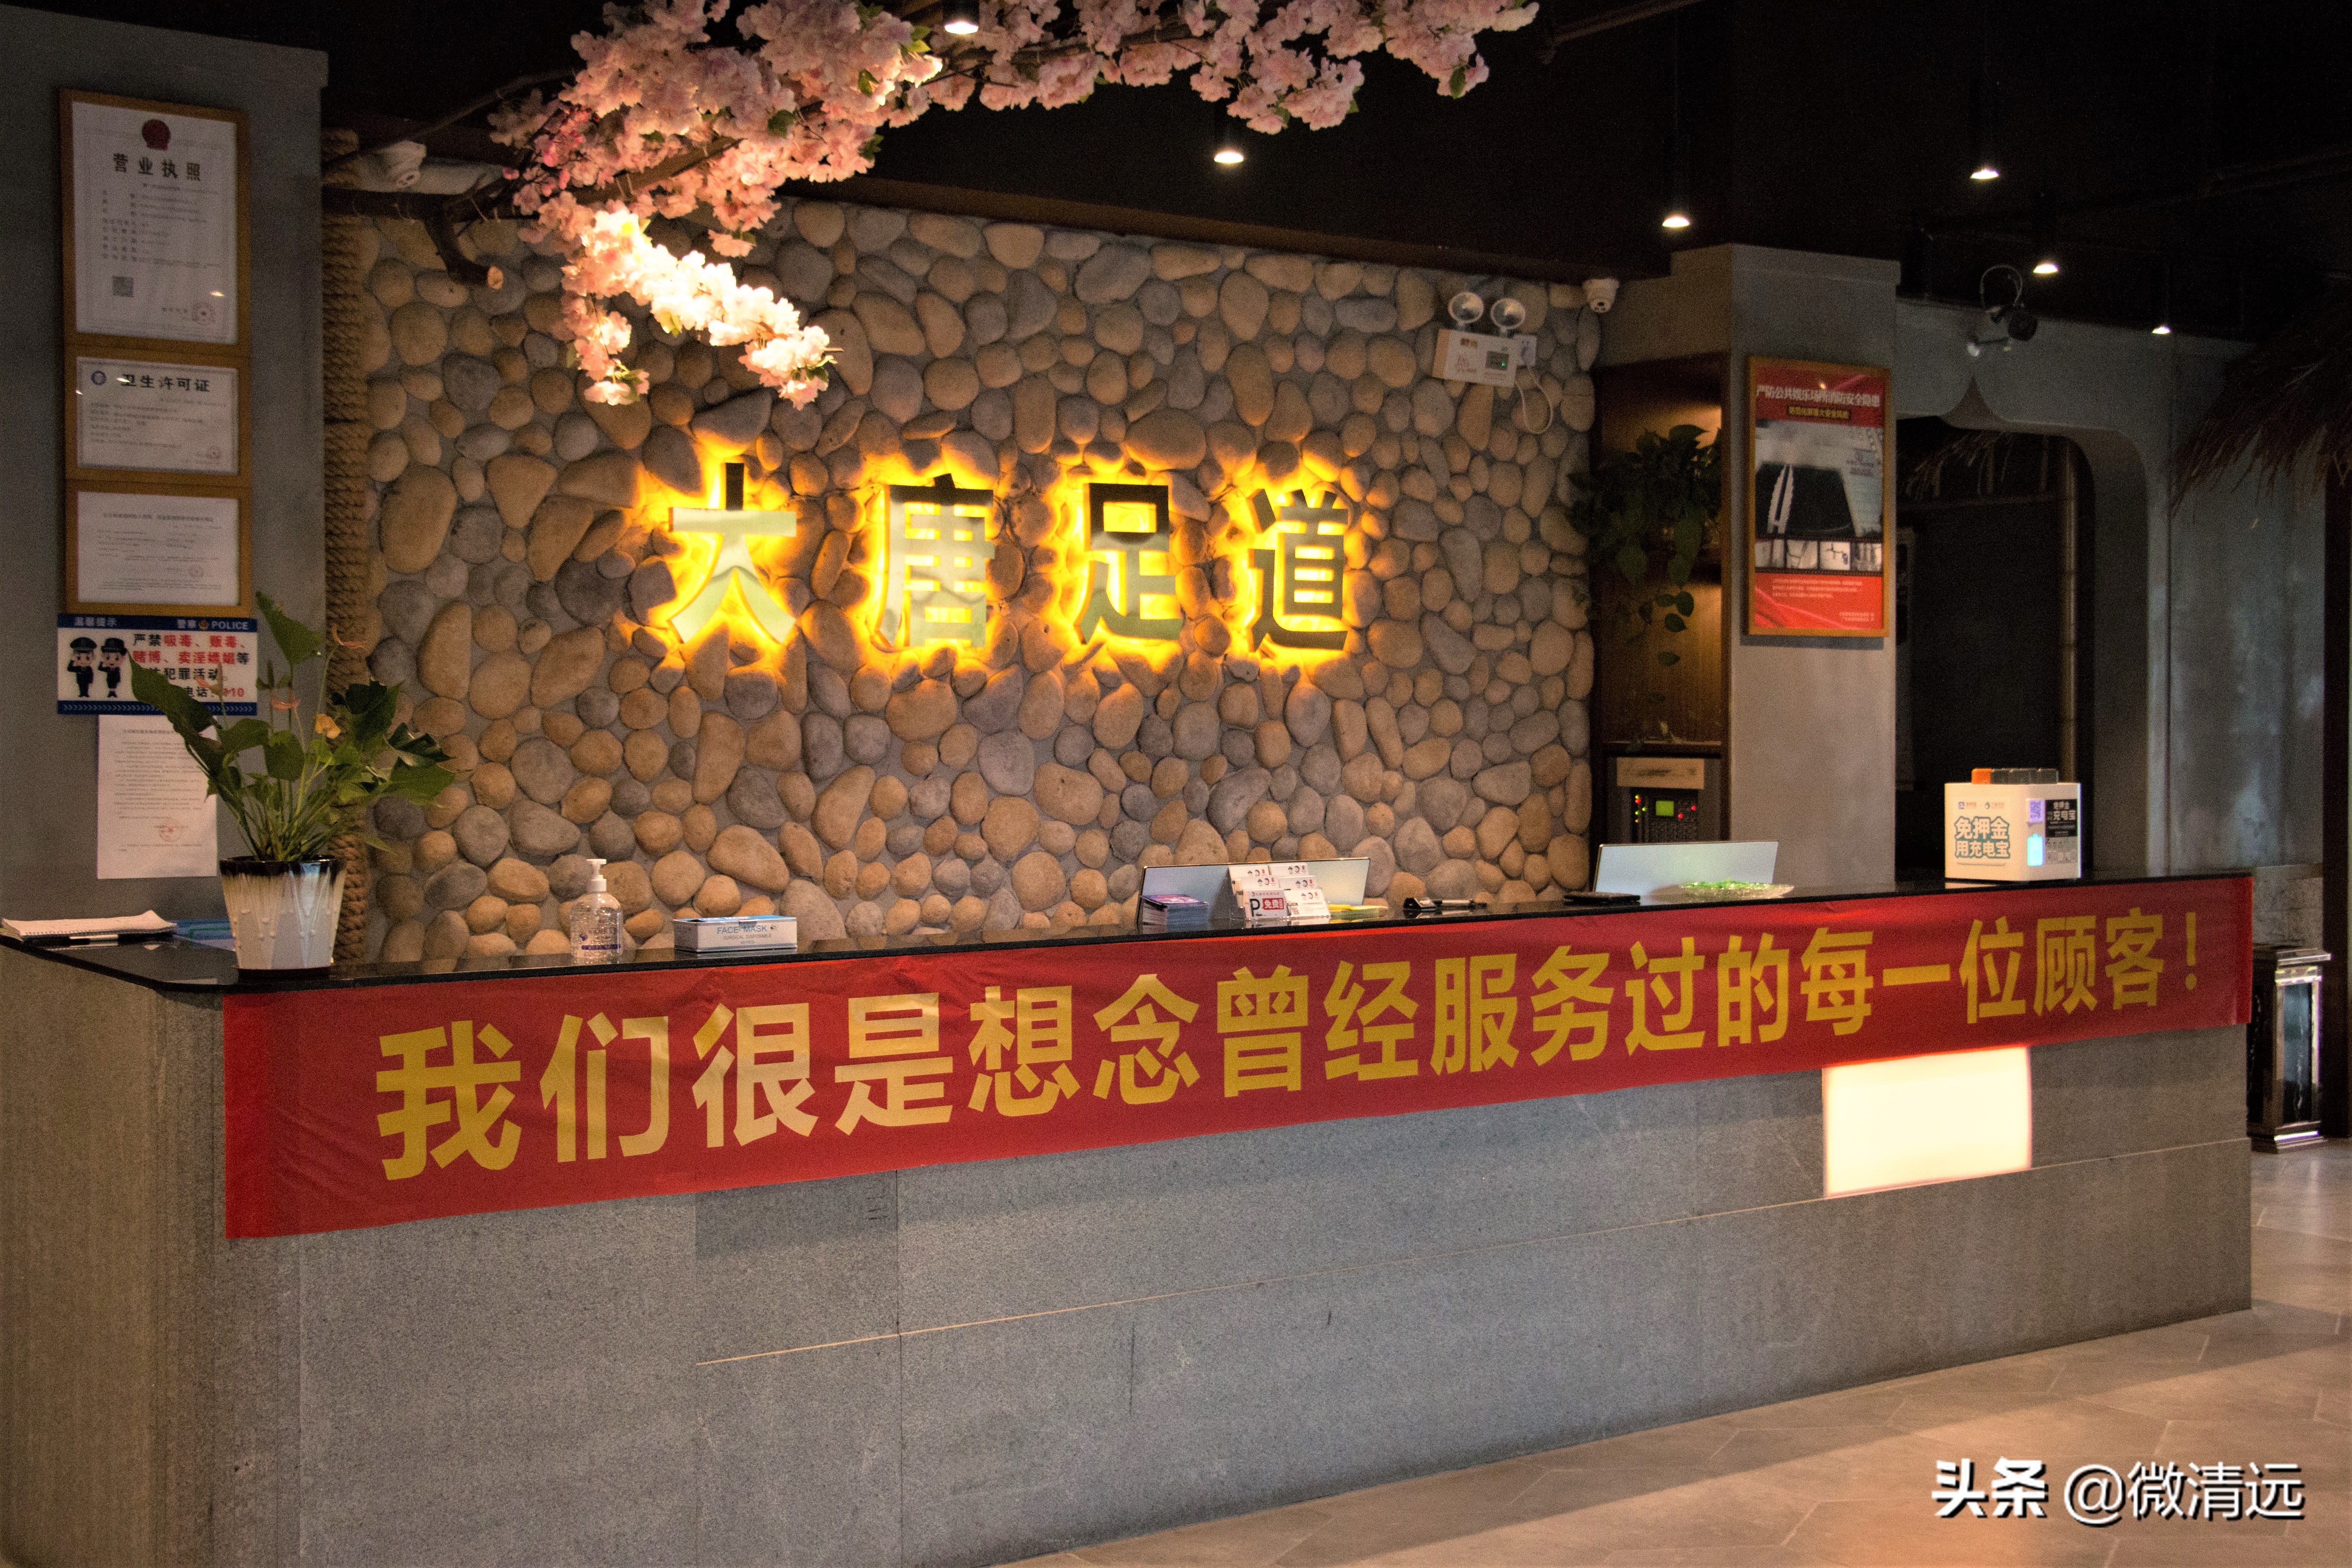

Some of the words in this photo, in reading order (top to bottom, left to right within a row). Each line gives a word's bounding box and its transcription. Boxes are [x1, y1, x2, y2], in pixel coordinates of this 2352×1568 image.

[113, 152, 201, 181] 营业执照
[121, 374, 210, 392] 卫生许可证
[667, 462, 1349, 652] 大唐足道
[177, 620, 196, 629] 警察
[211, 621, 248, 630] POLICE
[1954, 816, 2010, 840] 免押金
[1954, 840, 2011, 859] 用充电宝
[1250, 898, 1260, 917] P
[1264, 899, 1279, 909] 免费
[376, 908, 2198, 1181] 我们很是想念曾经服务过的每一位顾客！
